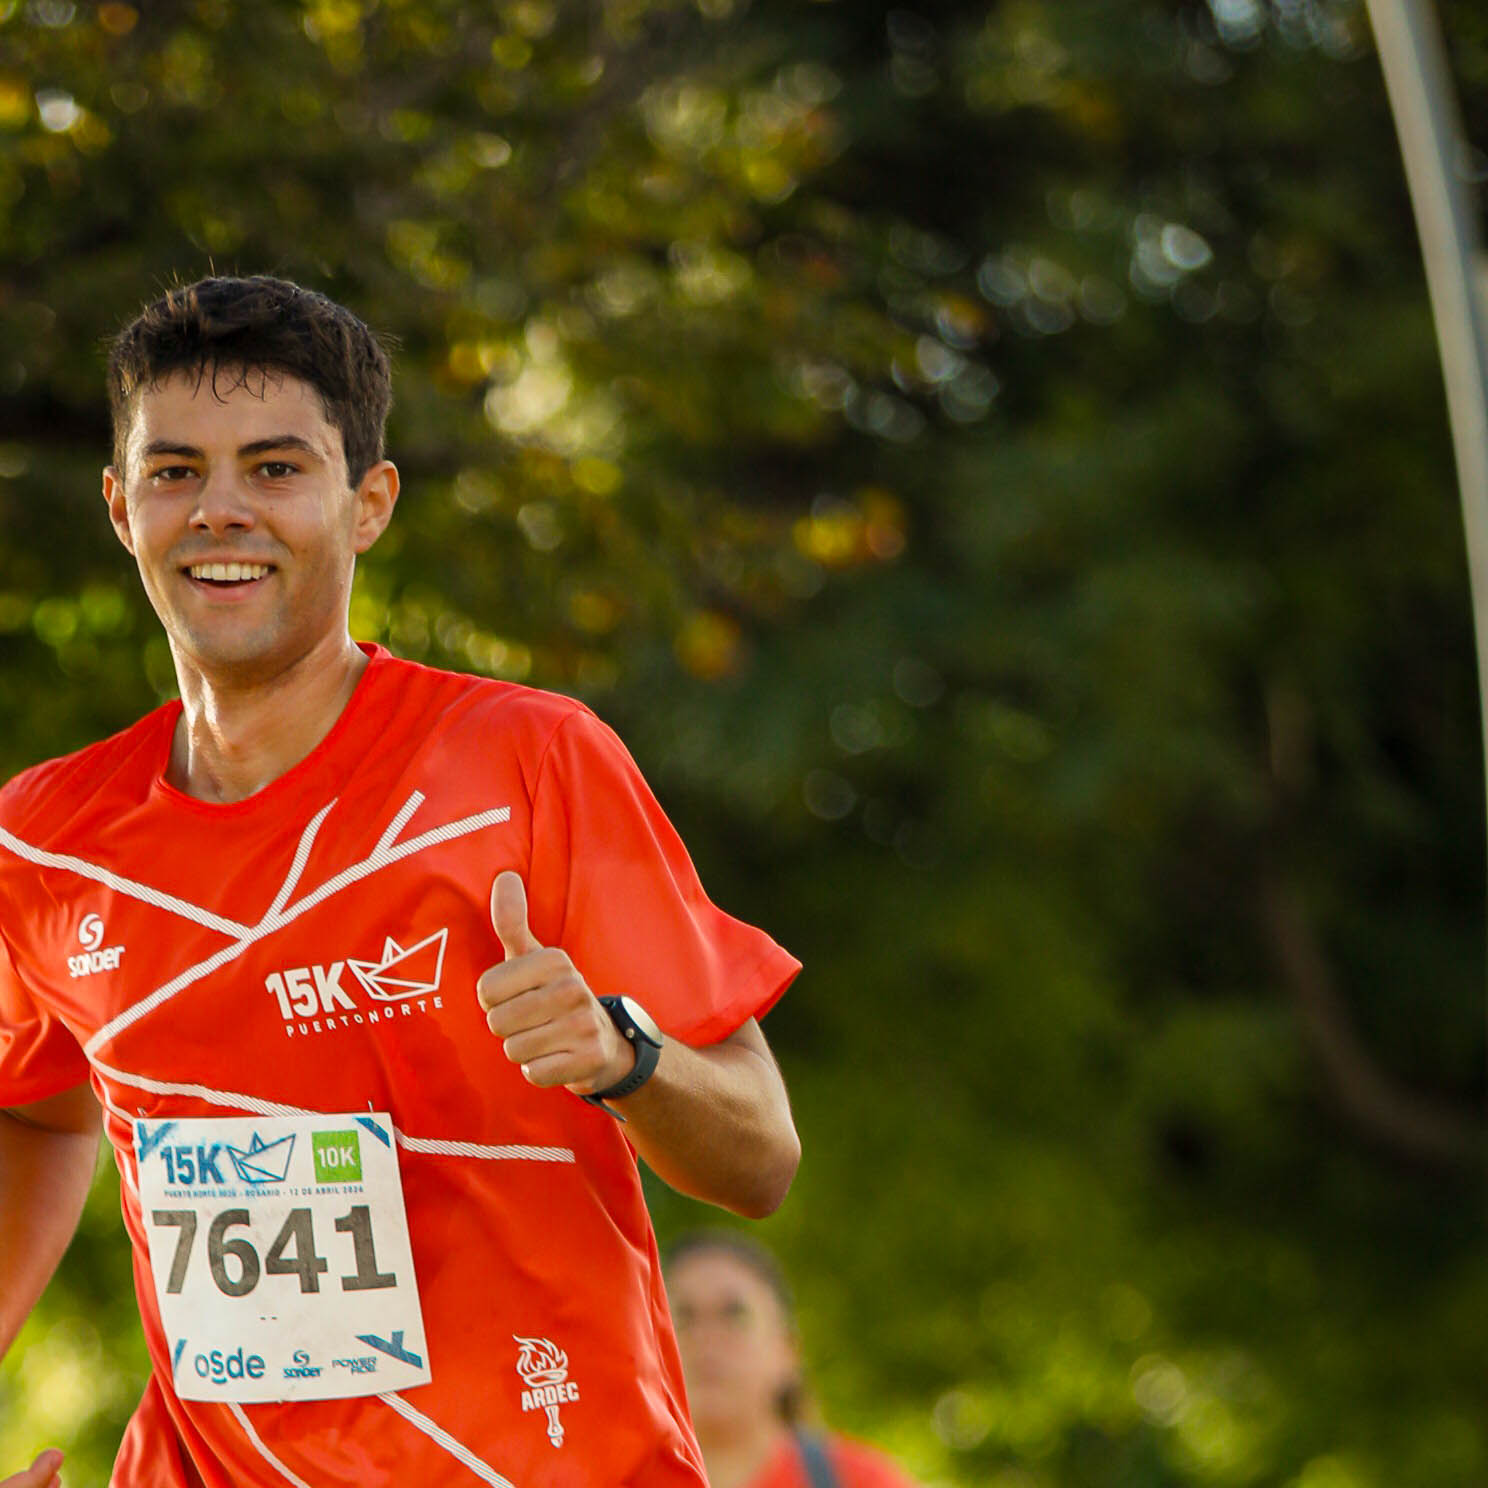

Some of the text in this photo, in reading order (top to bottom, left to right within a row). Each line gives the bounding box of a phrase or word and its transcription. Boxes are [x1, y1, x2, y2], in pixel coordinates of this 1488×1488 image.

[264, 961, 358, 1020] 15K
[160, 1144, 225, 1184] 15K
[317, 1145, 357, 1169] 10K
[152, 1205, 397, 1297] 7641
[194, 1346, 266, 1381] osde
[521, 1382, 580, 1412] ARDEC
